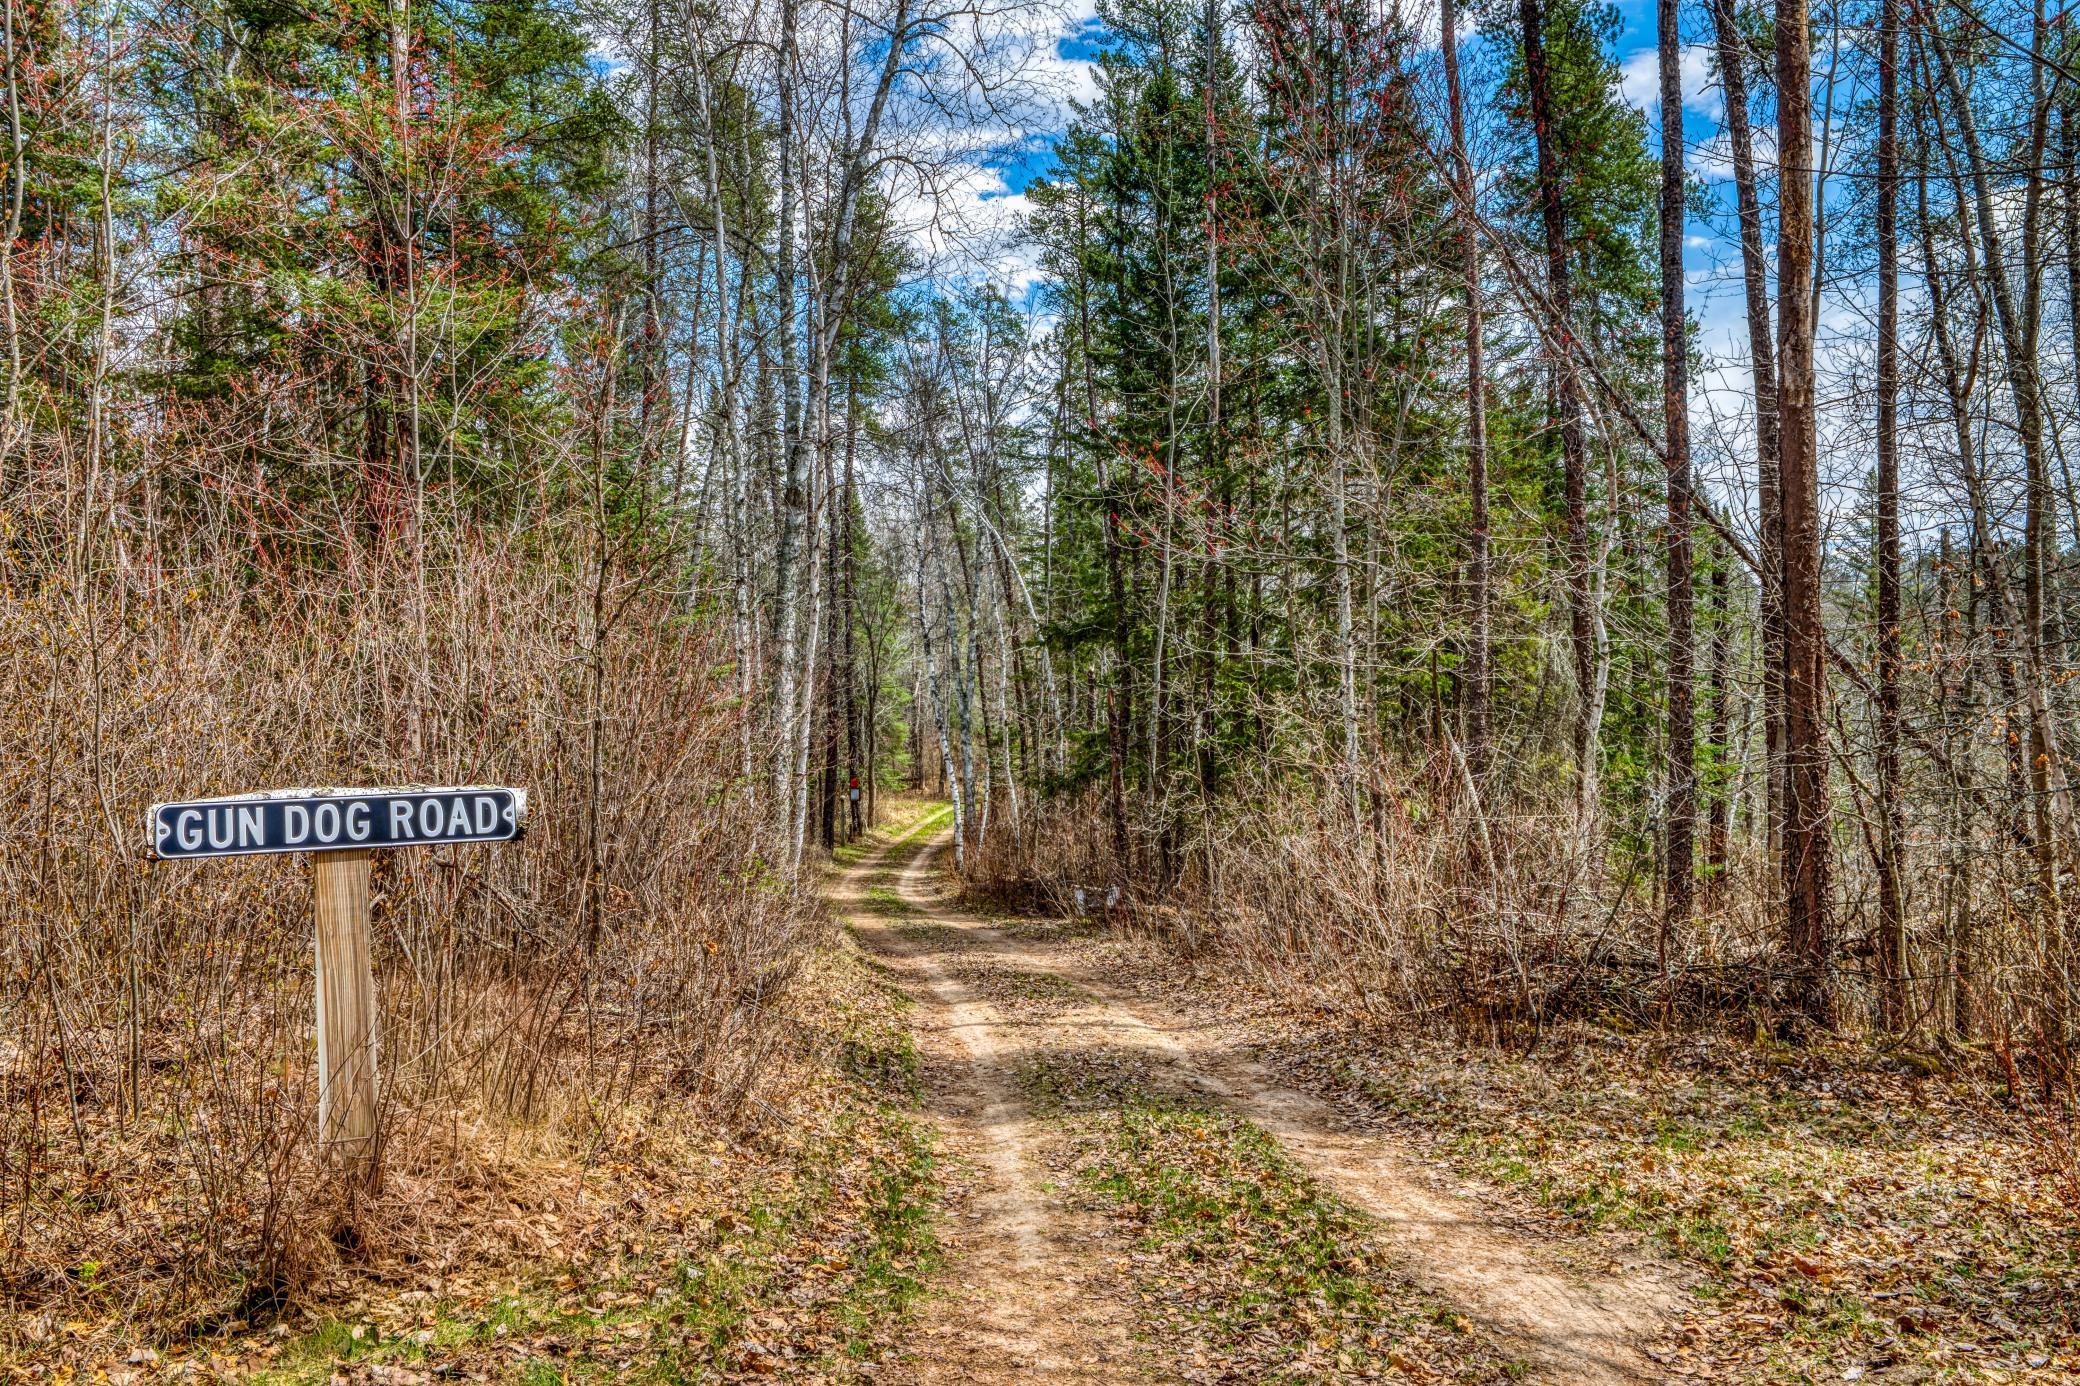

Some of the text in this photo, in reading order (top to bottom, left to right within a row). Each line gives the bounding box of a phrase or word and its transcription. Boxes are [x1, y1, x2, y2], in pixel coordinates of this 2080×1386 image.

[176, 797, 499, 851] GUN DOG ROAD
